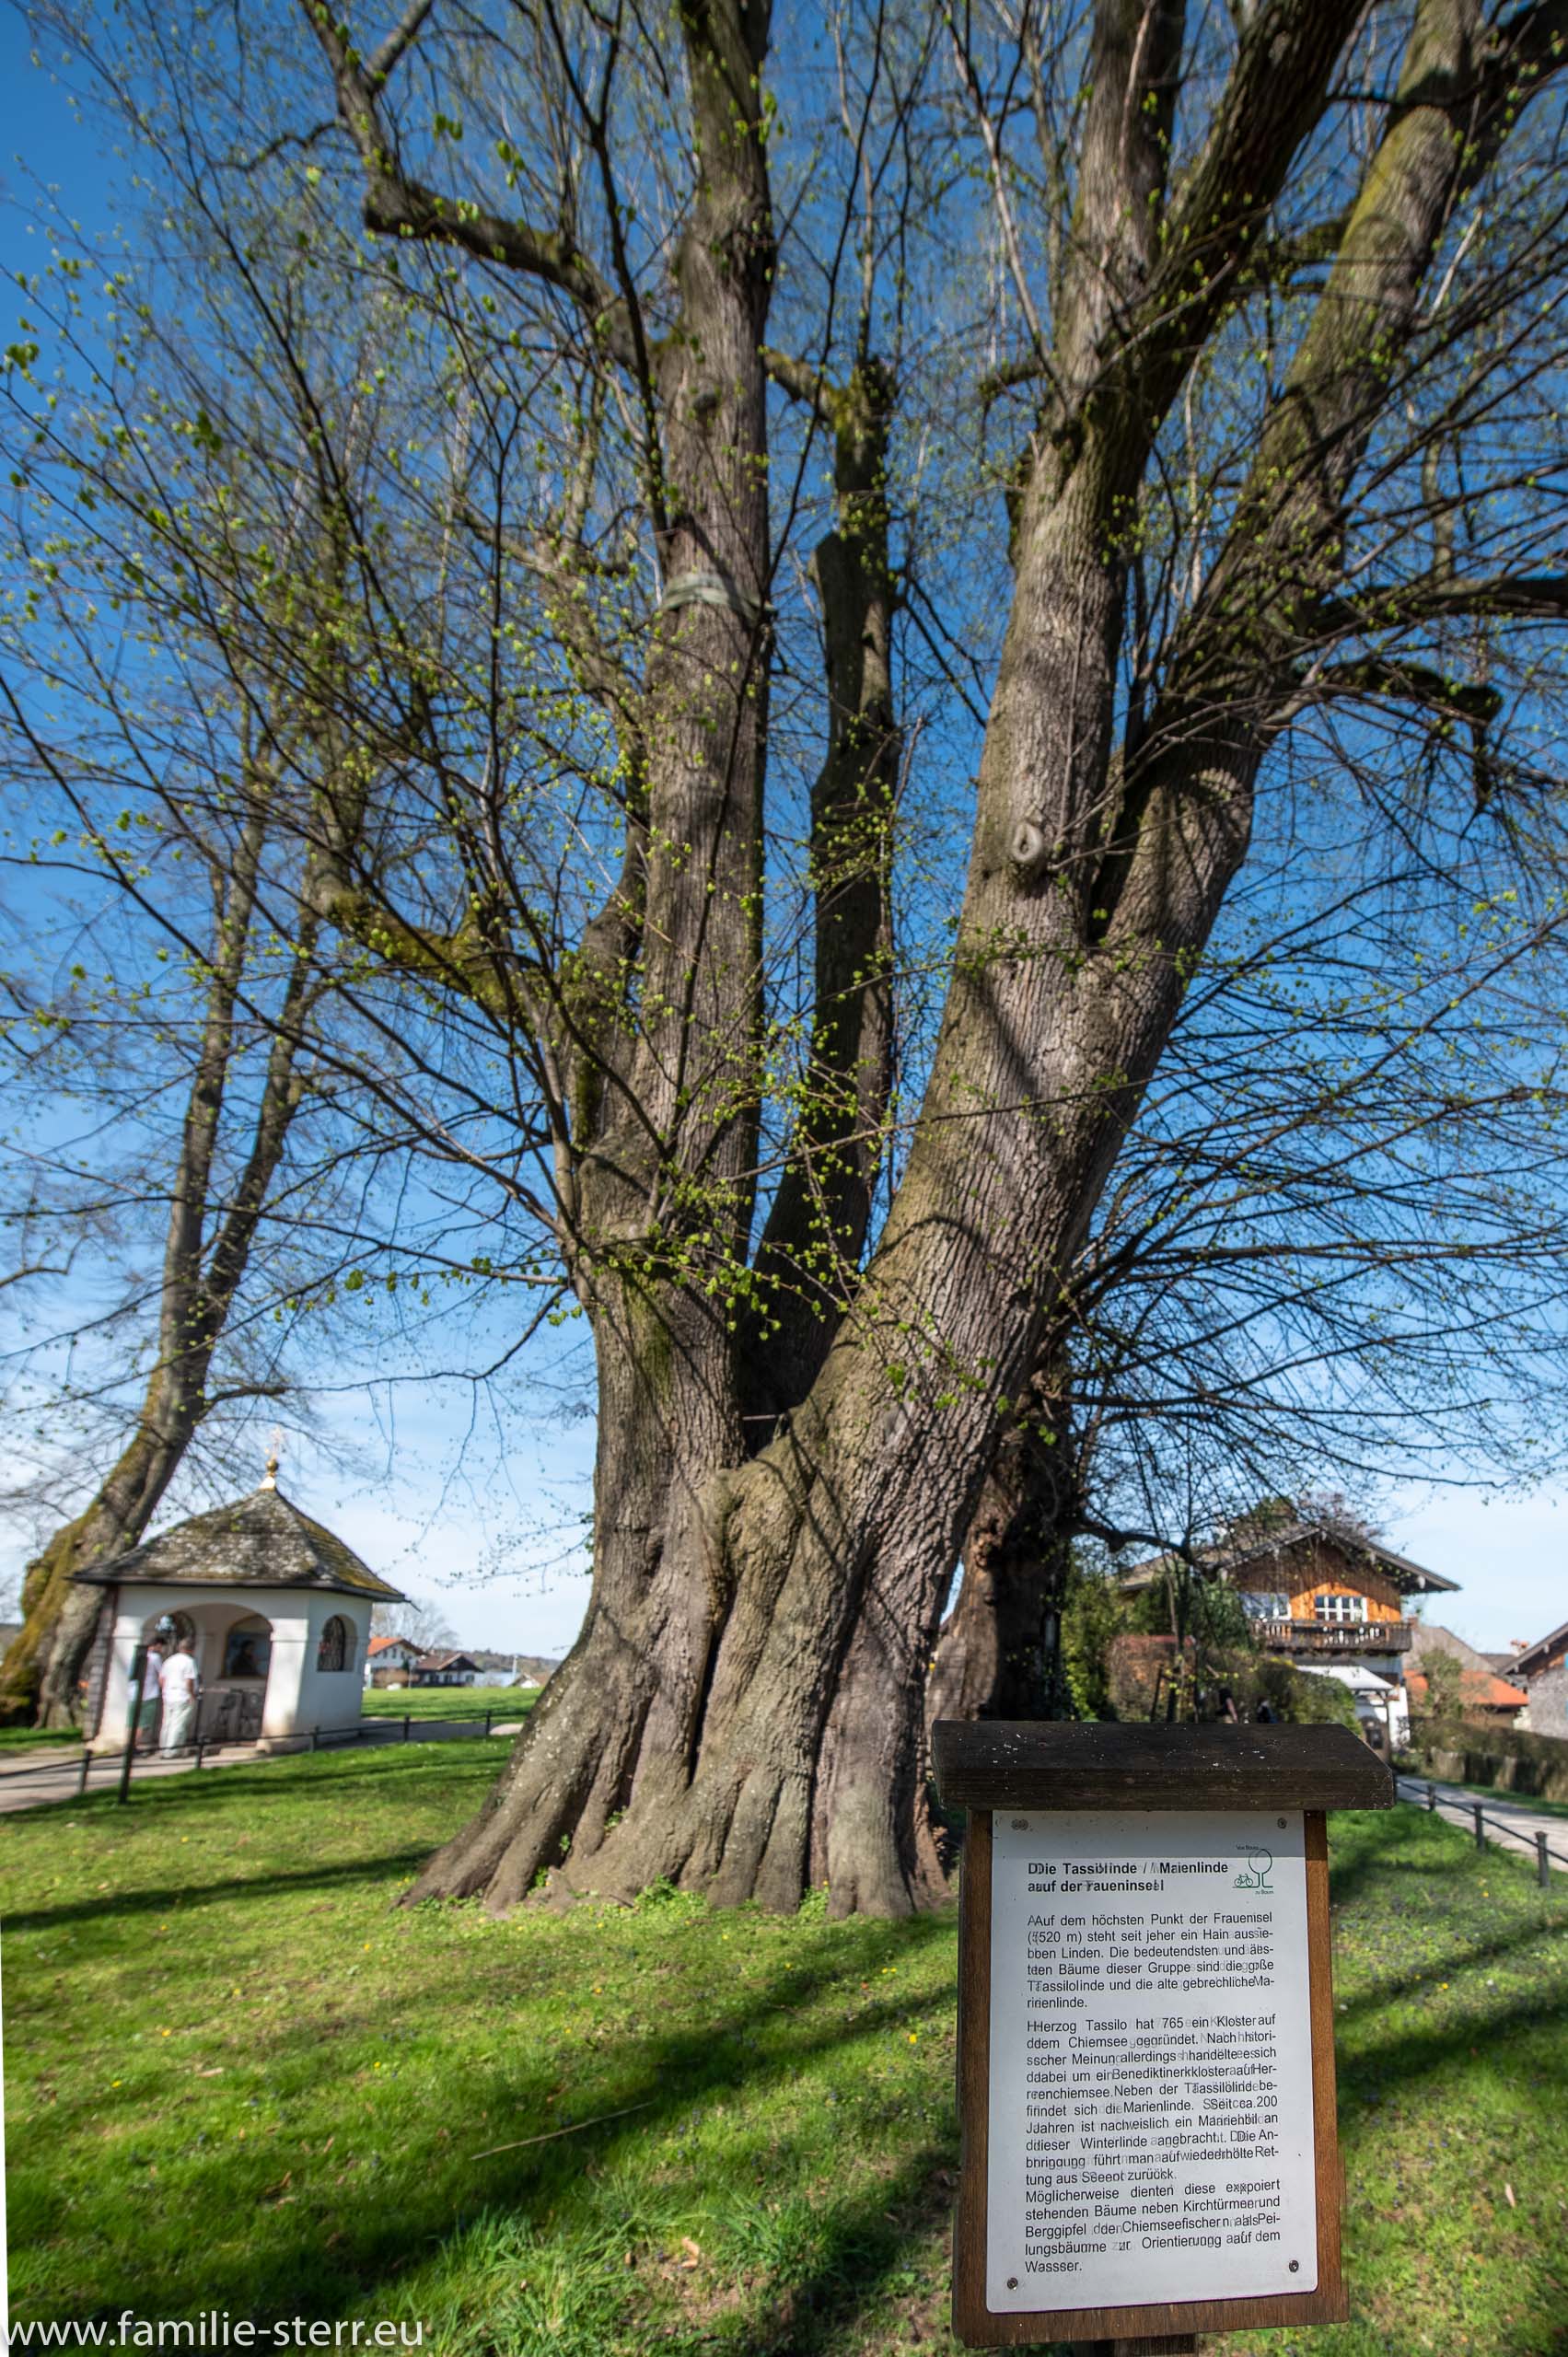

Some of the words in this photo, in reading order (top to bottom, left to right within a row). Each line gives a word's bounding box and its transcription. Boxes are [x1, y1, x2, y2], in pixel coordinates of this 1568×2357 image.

[1061, 1880, 1081, 1892] der
[1061, 1914, 1086, 1925] dem
[1092, 1914, 1144, 1925] höchsten
[1151, 1913, 1183, 1924] Punkt
[1190, 1912, 1208, 1923] der
[1067, 1932, 1082, 1944] m)
[1087, 1931, 1115, 1941] steht
[1121, 1930, 1142, 1941] seit
[1145, 1929, 1174, 1943] jeher
[1180, 1929, 1197, 1940] ein
[1203, 1929, 1228, 1939] Hain
[1062, 1947, 1104, 1958] Linden.
[1109, 1946, 1129, 1958] Die
[1134, 1945, 1218, 1957] bedeutendsten
[1225, 1945, 1245, 1956] und
[1059, 1963, 1099, 1975] Bäume
[1106, 1962, 1141, 1974] dieser
[1148, 1962, 1191, 1975] Gruppe
[1197, 1961, 1220, 1972] sind
[1226, 1961, 1242, 1972] die
[1109, 1980, 1131, 1991] und
[1136, 1980, 1153, 1991] die
[1157, 1979, 1178, 1990] alte
[1183, 1978, 1254, 1991] gebrechliche
[1086, 2019, 1127, 2031] Tassilo
[1136, 2019, 1154, 2030] hat
[1162, 2018, 1183, 2028] 765
[1191, 2017, 1209, 2028] ein
[1211, 2016, 1256, 2027] Kloster
[1258, 2014, 1276, 2026] auf
[1068, 2036, 1127, 2049] Chiemsee
[1201, 2033, 1237, 2044] Nach
[1120, 2050, 1177, 2064] allerdings
[1180, 2049, 1237, 2061] handelte
[1073, 2071, 1090, 2082] um
[1253, 2064, 1277, 2075] Her-
[1114, 2084, 1152, 2096] Neben
[1159, 2084, 1178, 2095] der
[1259, 2081, 1277, 2092] be-
[1074, 2104, 1098, 2115] sich
[1123, 2100, 1194, 2113] Marienlinde.
[1257, 2096, 1277, 2107] 200
[1081, 2121, 1095, 2132] ist
[1175, 2117, 1192, 2129] ein
[1264, 2114, 1278, 2123] an
[1081, 2135, 1147, 2149] Winterlinde
[1258, 2130, 1279, 2141] An-
[1094, 2154, 1121, 2166] führt
[1122, 2155, 1154, 2165] man
[1255, 2147, 1279, 2157] Ret-
[1026, 2173, 1051, 2188] tung
[1056, 2174, 1077, 2184] aus
[1026, 2189, 1119, 2205] Möglicherweise
[1131, 2185, 1173, 2198] dienten
[1184, 2183, 1215, 2195] diese
[1026, 2207, 1088, 2220] stehenden
[1095, 2205, 1136, 2216] Bäume
[1142, 2202, 1179, 2214] neben
[1259, 2197, 1280, 2208] und
[1026, 2223, 1087, 2239] Berggipfel
[1258, 2214, 1281, 2224] Pei-
[1255, 2231, 1280, 2242] dem
